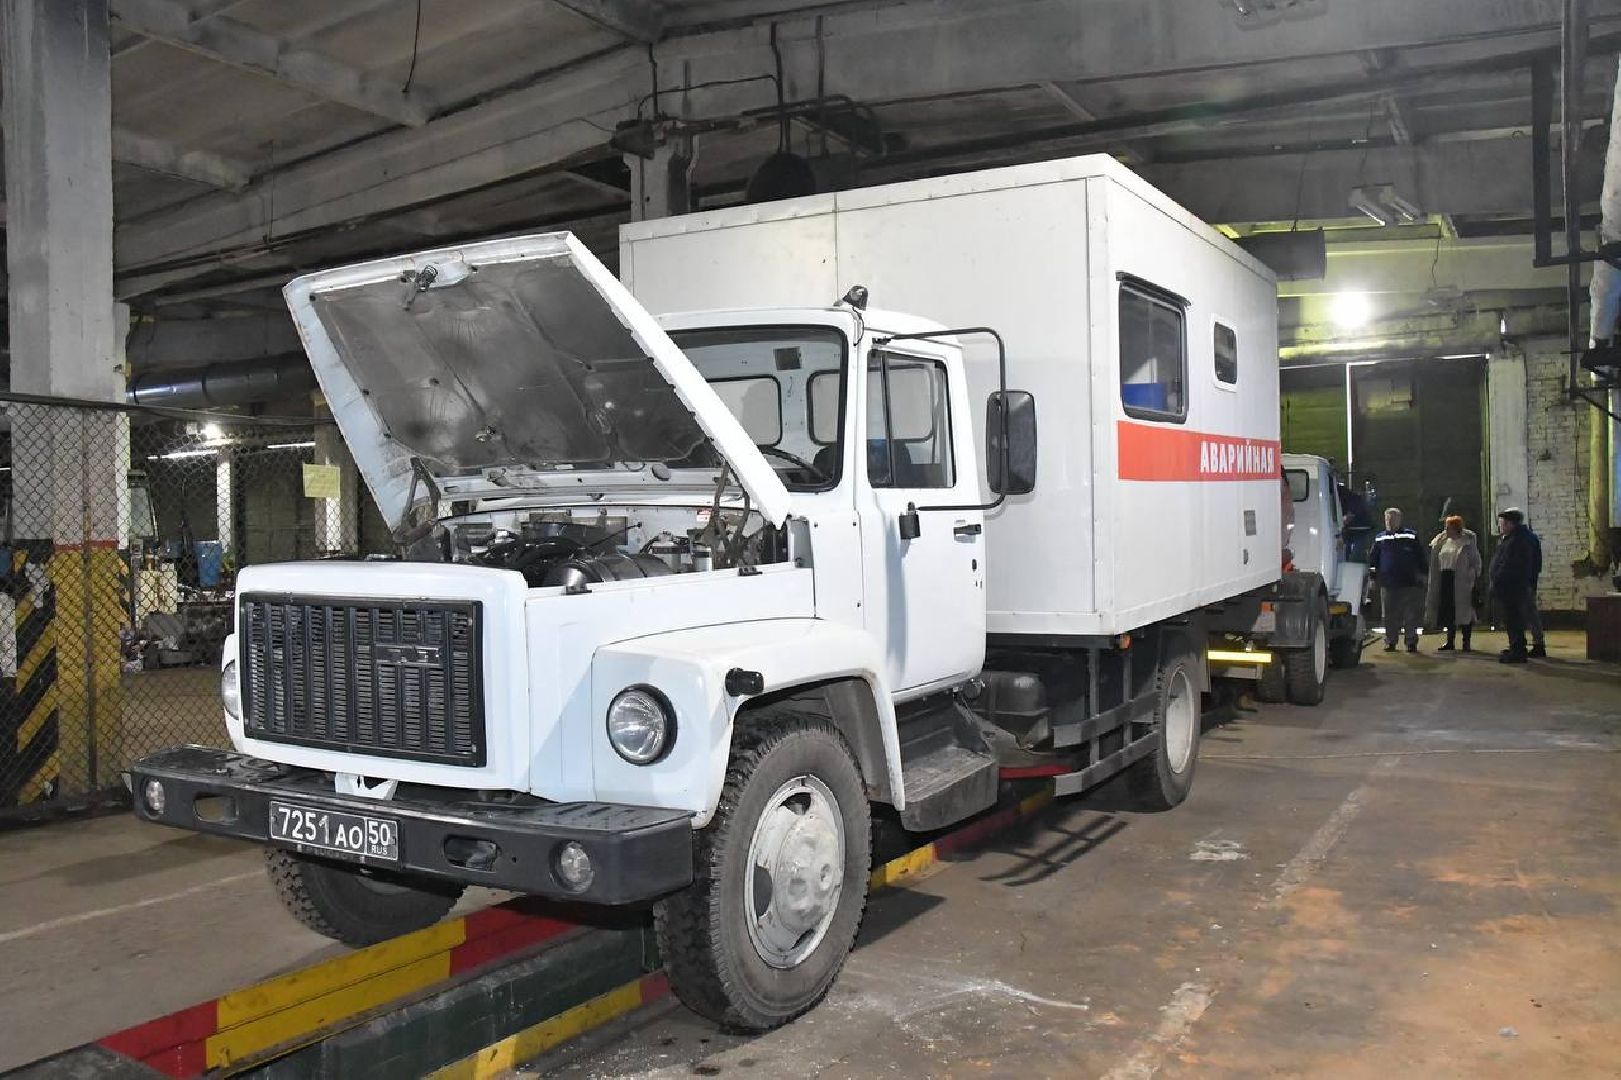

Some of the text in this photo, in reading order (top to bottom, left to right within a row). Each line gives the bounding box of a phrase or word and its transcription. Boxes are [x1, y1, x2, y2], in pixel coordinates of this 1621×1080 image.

[1200, 440, 1274, 473] АВАРИЙНАЯ
[278, 808, 330, 844] 7251
[368, 821, 391, 846] 50
[371, 845, 388, 855] RUS
